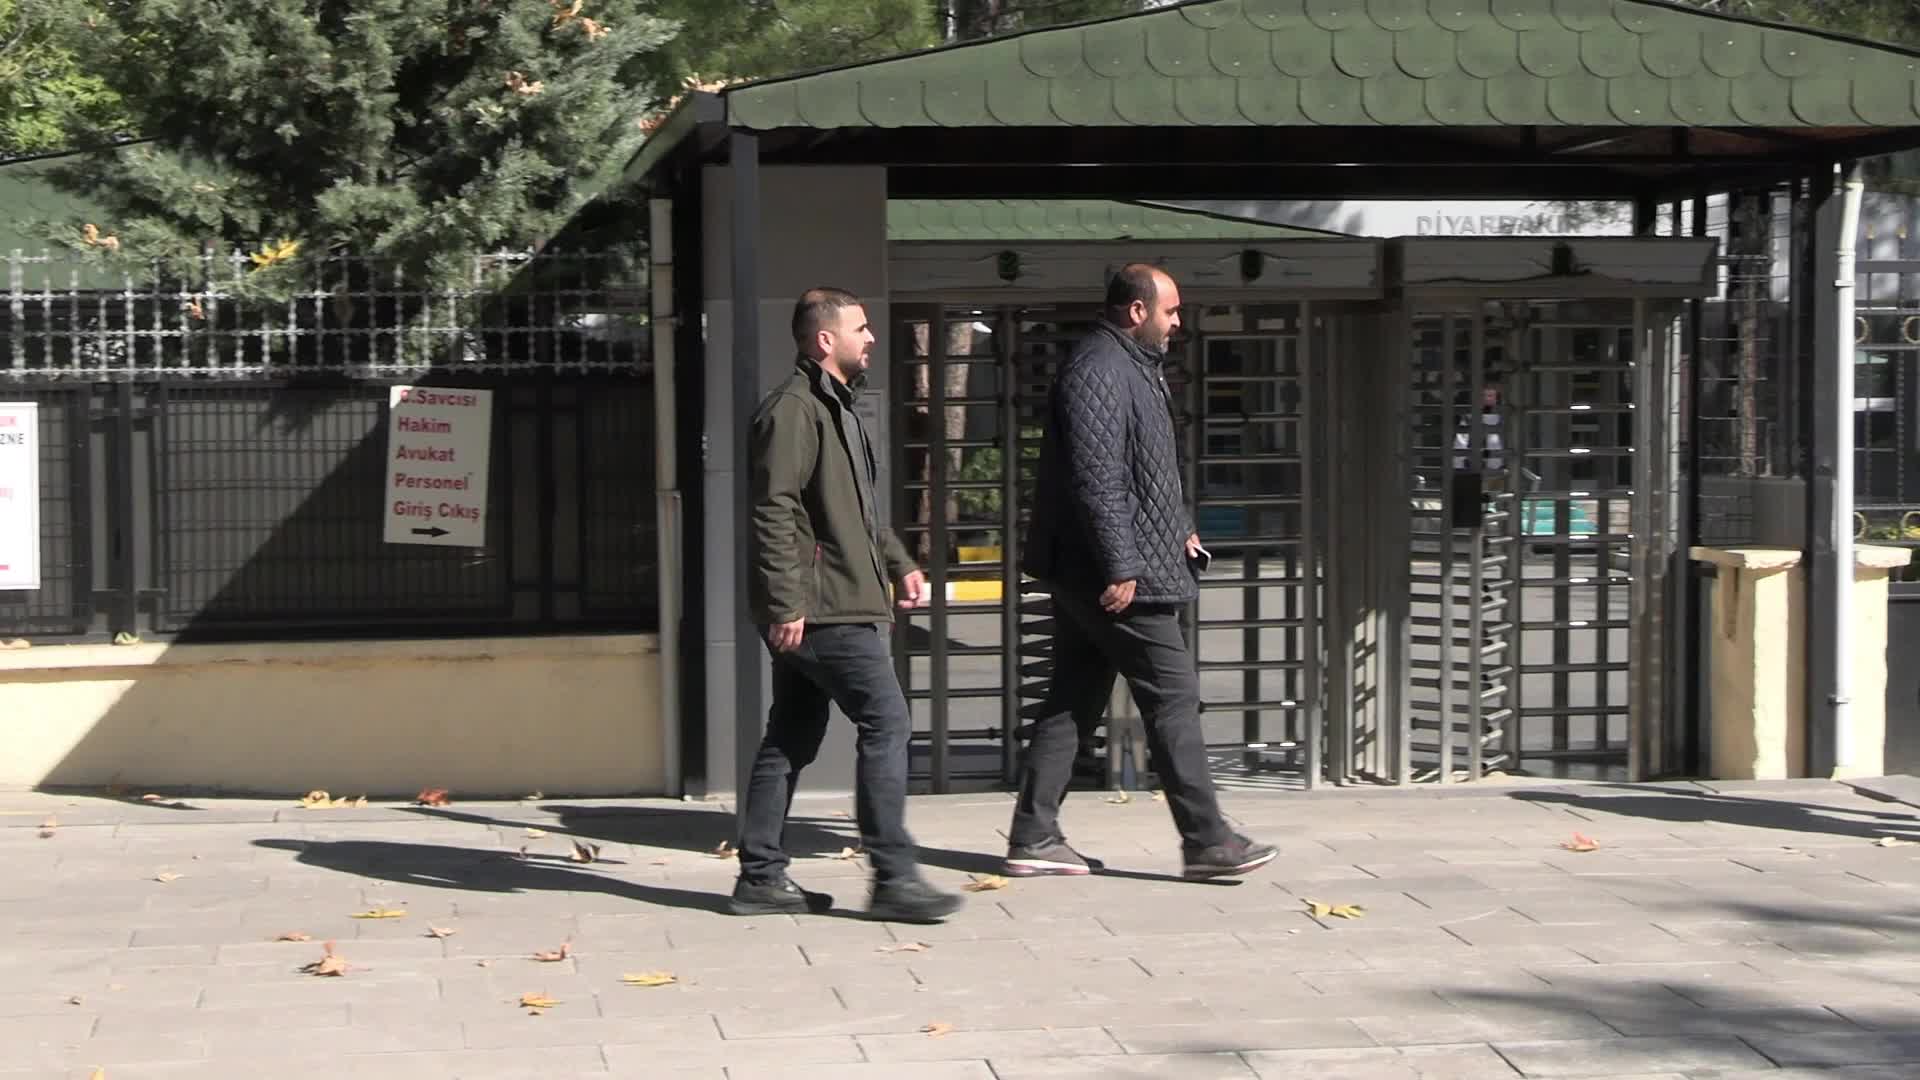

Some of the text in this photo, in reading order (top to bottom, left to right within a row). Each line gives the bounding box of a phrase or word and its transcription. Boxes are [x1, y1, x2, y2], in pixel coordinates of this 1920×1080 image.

[397, 417, 452, 434] Hakim
[395, 445, 456, 463] Avukat
[394, 472, 469, 490] Personel
[393, 500, 433, 521] Giriş
